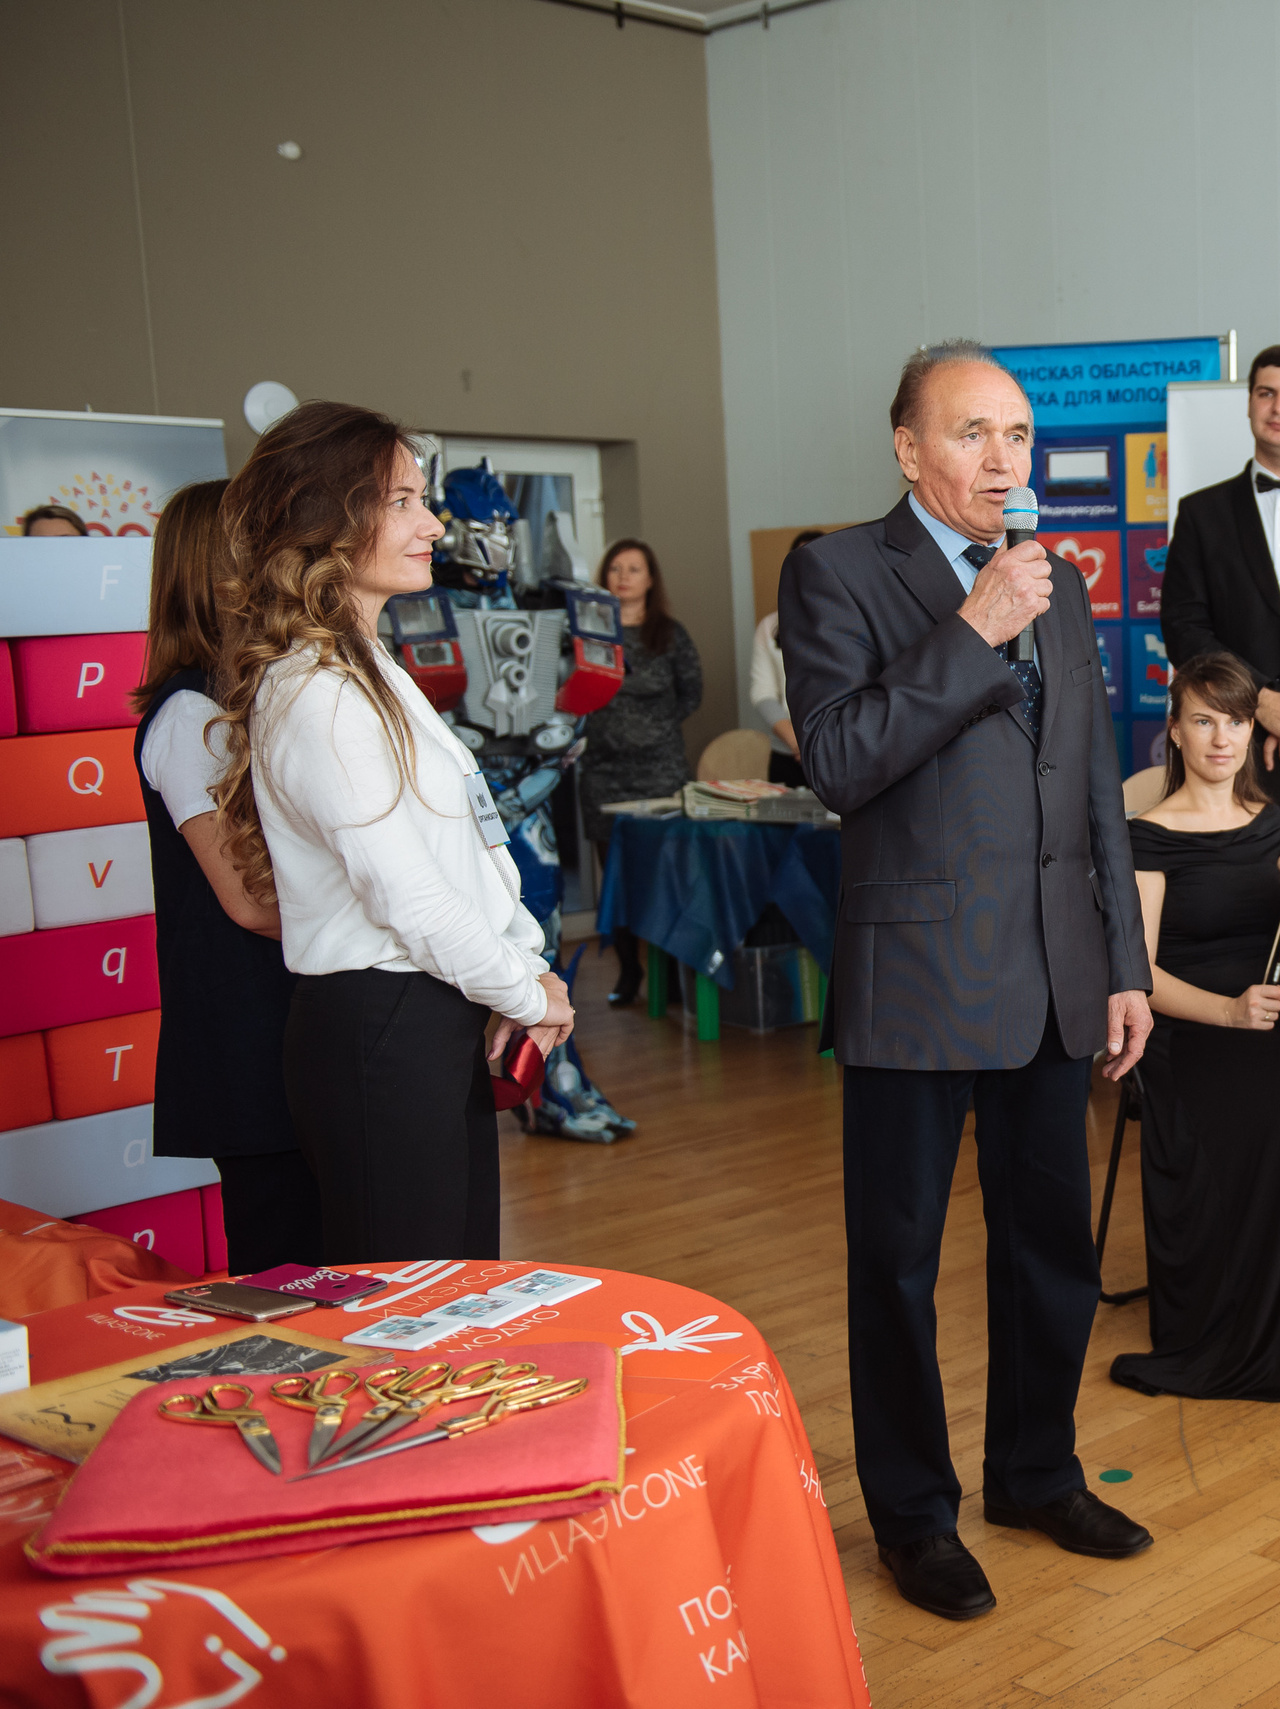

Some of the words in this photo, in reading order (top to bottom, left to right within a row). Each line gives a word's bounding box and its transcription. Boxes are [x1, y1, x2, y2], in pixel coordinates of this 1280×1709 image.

[1015, 365, 1084, 383] ИНСКАЯ
[1088, 359, 1201, 380] ОБЛАСТНАЯ
[1063, 389, 1103, 408] ДЛЯ
[1106, 385, 1167, 404] МОЛОД
[76, 662, 105, 699] P
[67, 756, 103, 797] Q
[101, 947, 127, 984] q
[105, 1044, 133, 1082] T
